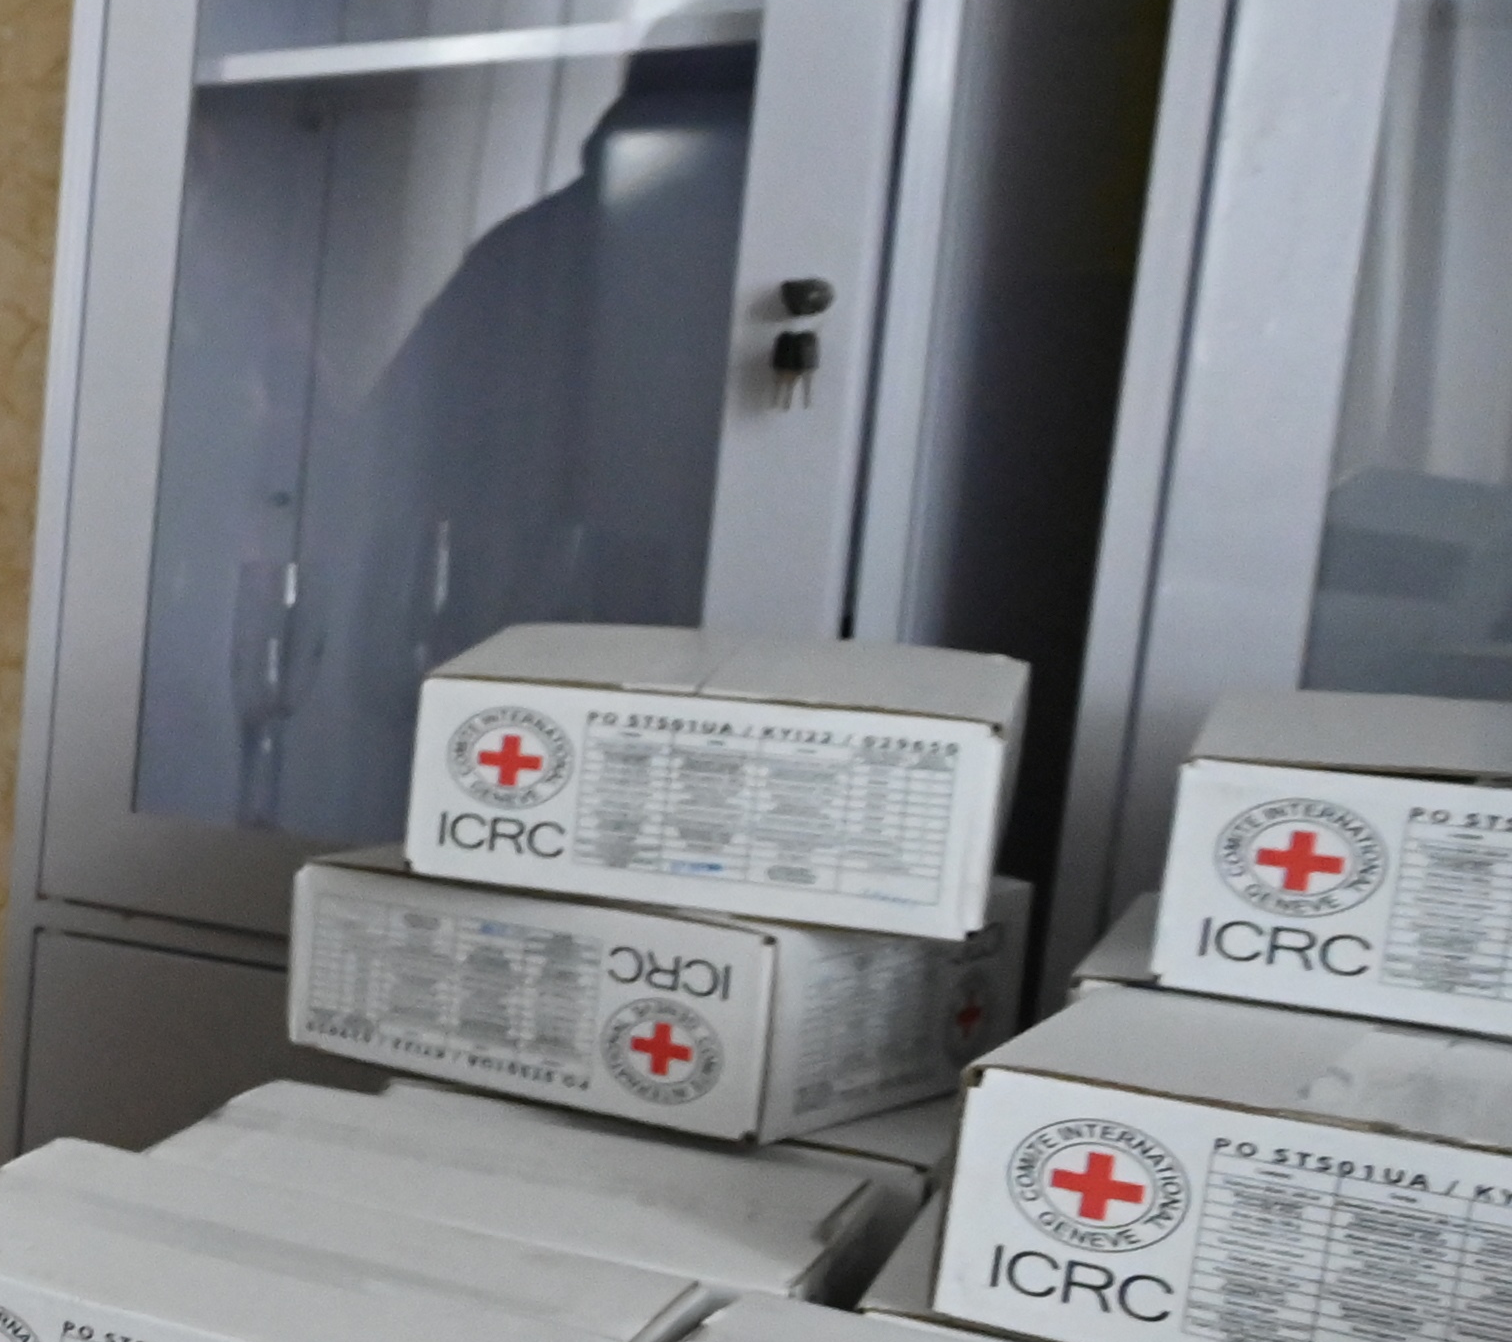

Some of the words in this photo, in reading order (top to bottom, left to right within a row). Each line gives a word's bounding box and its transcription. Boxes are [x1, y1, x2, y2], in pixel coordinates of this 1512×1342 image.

[438, 810, 568, 859] ICRC
[1408, 806, 1451, 824] PO
[608, 946, 733, 1001] ICRC
[1197, 917, 1372, 977] ICRC
[1014, 1130, 1057, 1202] COMITE
[1057, 1123, 1185, 1230] INTERNATIONAL
[1213, 1137, 1259, 1159] PO
[1274, 1147, 1431, 1192] STS01UA
[1038, 1209, 1142, 1249] GENEVE
[989, 1243, 1175, 1323] ICRC
[63, 1319, 94, 1342] PO
